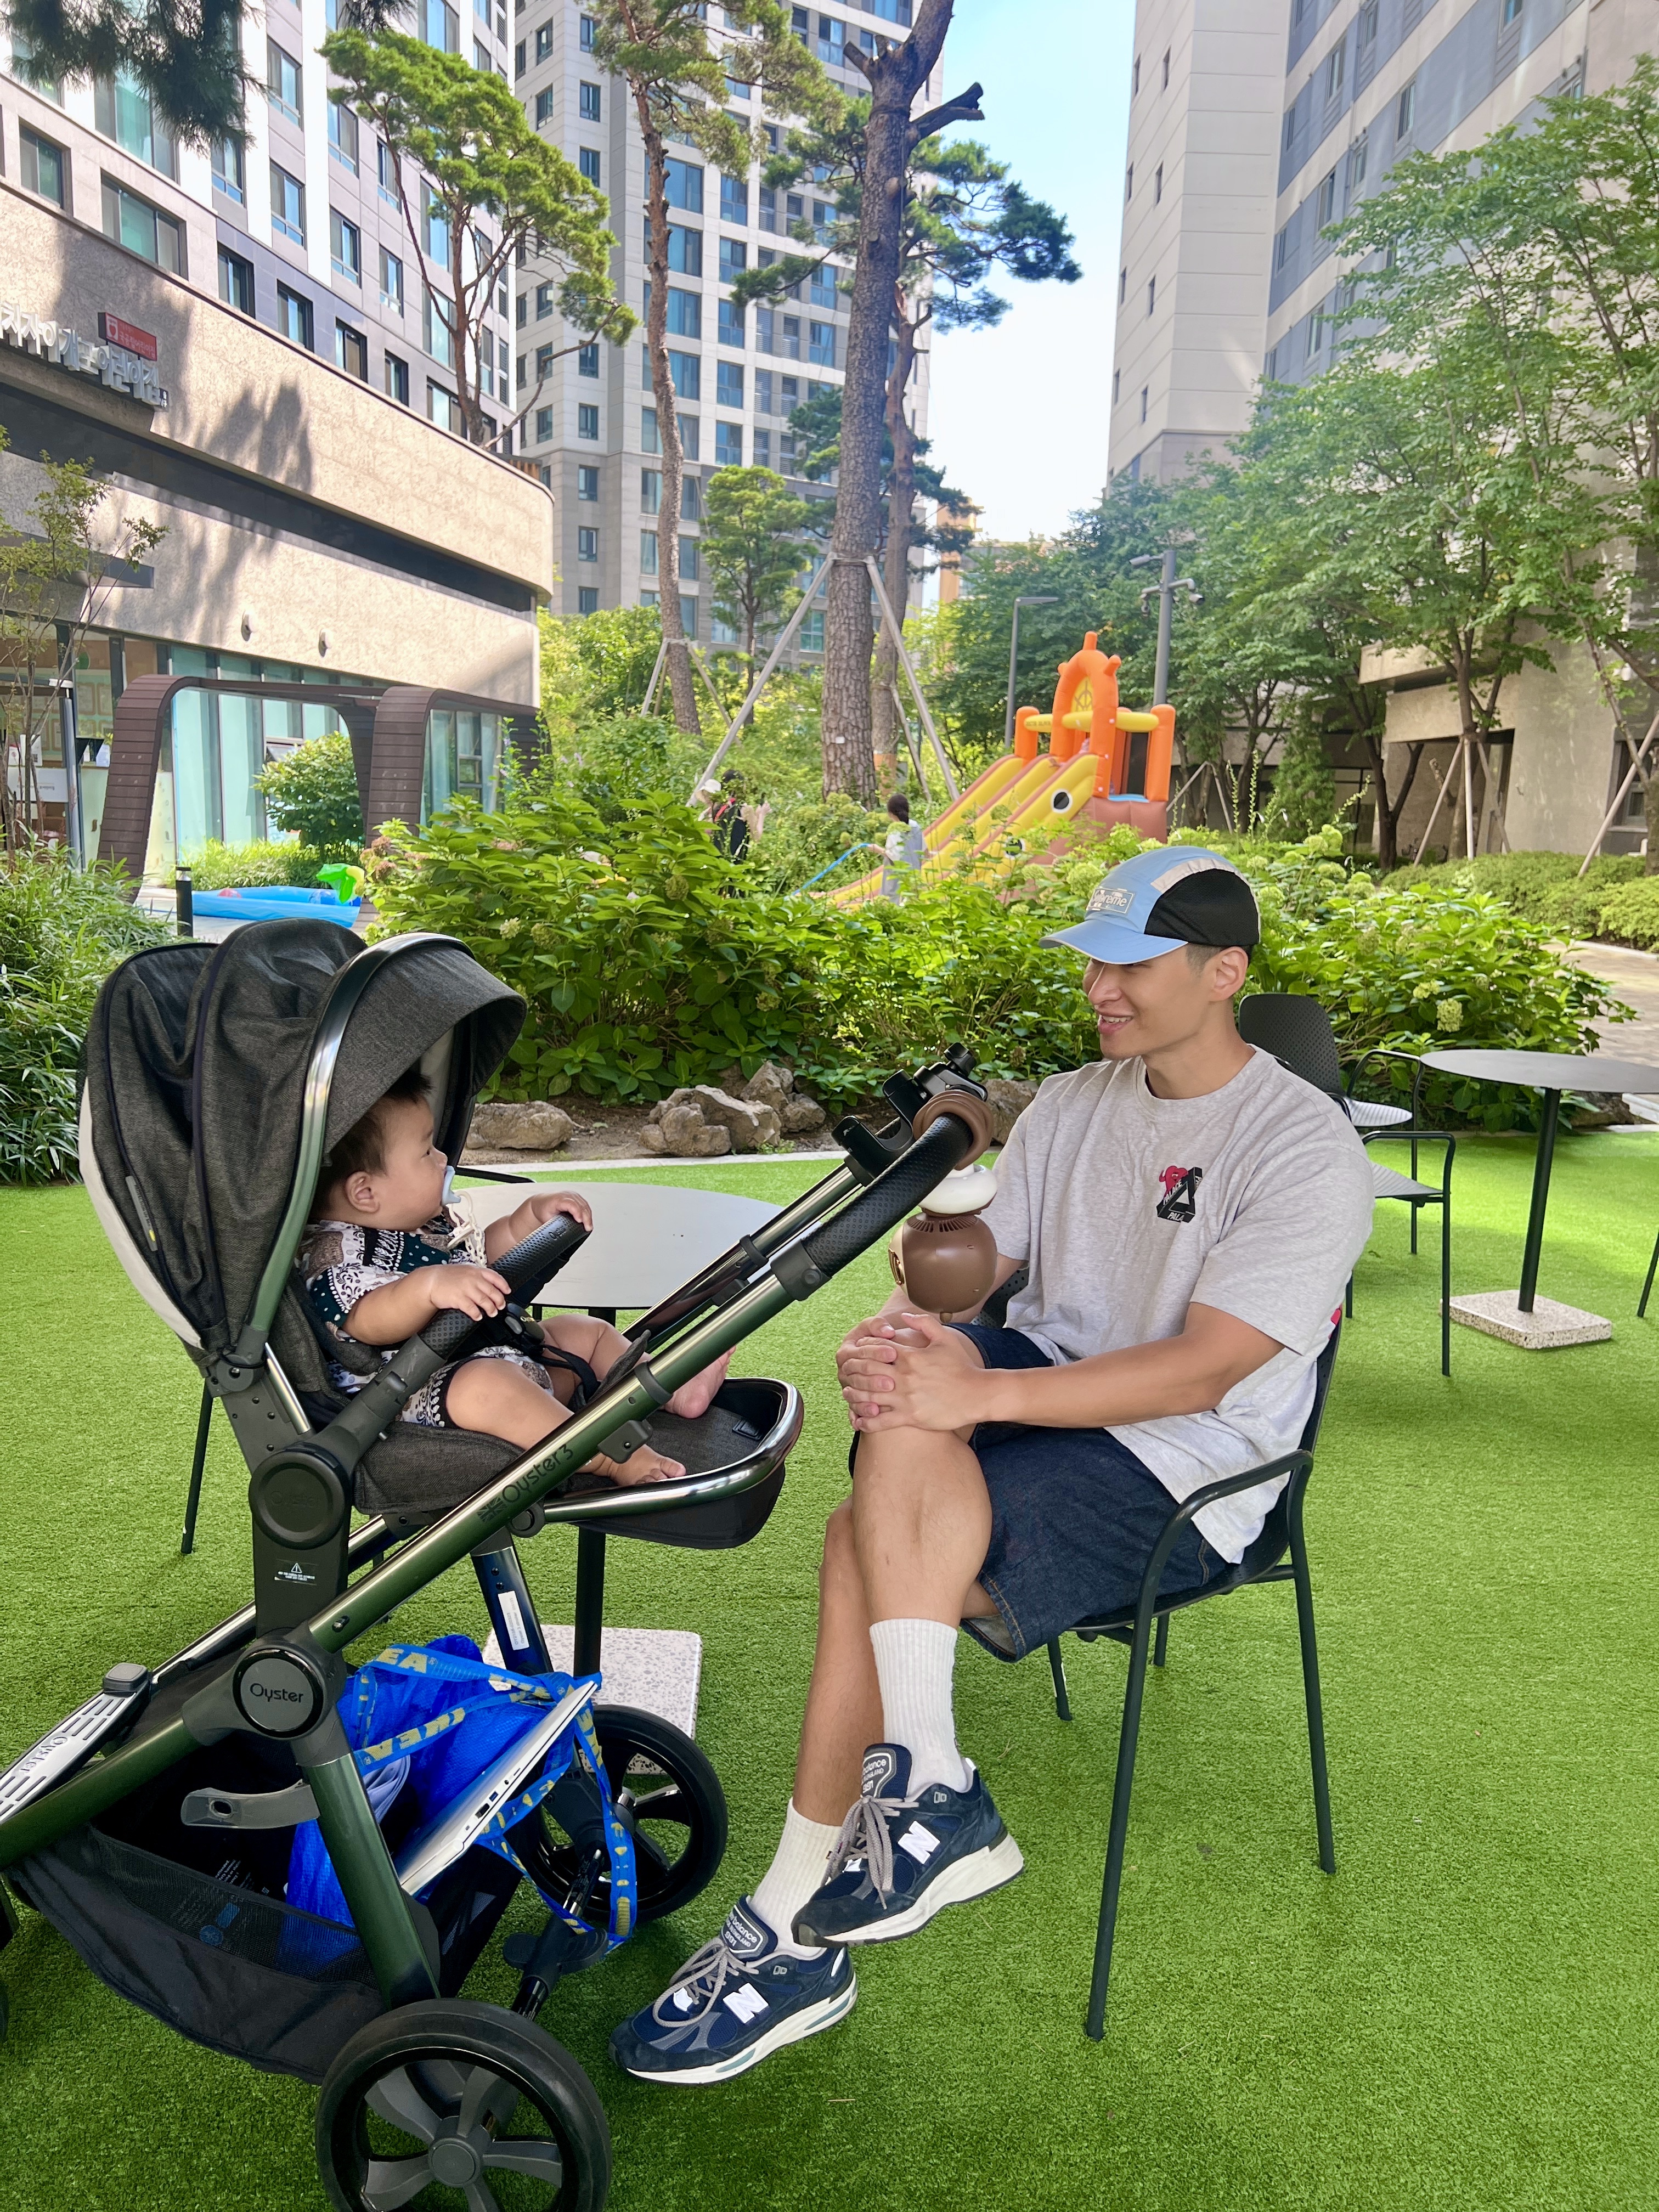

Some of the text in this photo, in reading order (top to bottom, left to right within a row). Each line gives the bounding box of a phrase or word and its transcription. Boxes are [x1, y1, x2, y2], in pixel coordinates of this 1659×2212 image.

[0, 302, 160, 406] 치자이개포어린이집
[119, 331, 155, 358] 국공립어린이집
[1163, 1179, 1183, 1205] PALACE
[375, 1647, 428, 1674] EA
[250, 1683, 304, 1703] Oyster
[20, 1736, 68, 1772] Oyster
[724, 1931, 737, 1947] 991
[732, 1916, 758, 1943] balance
